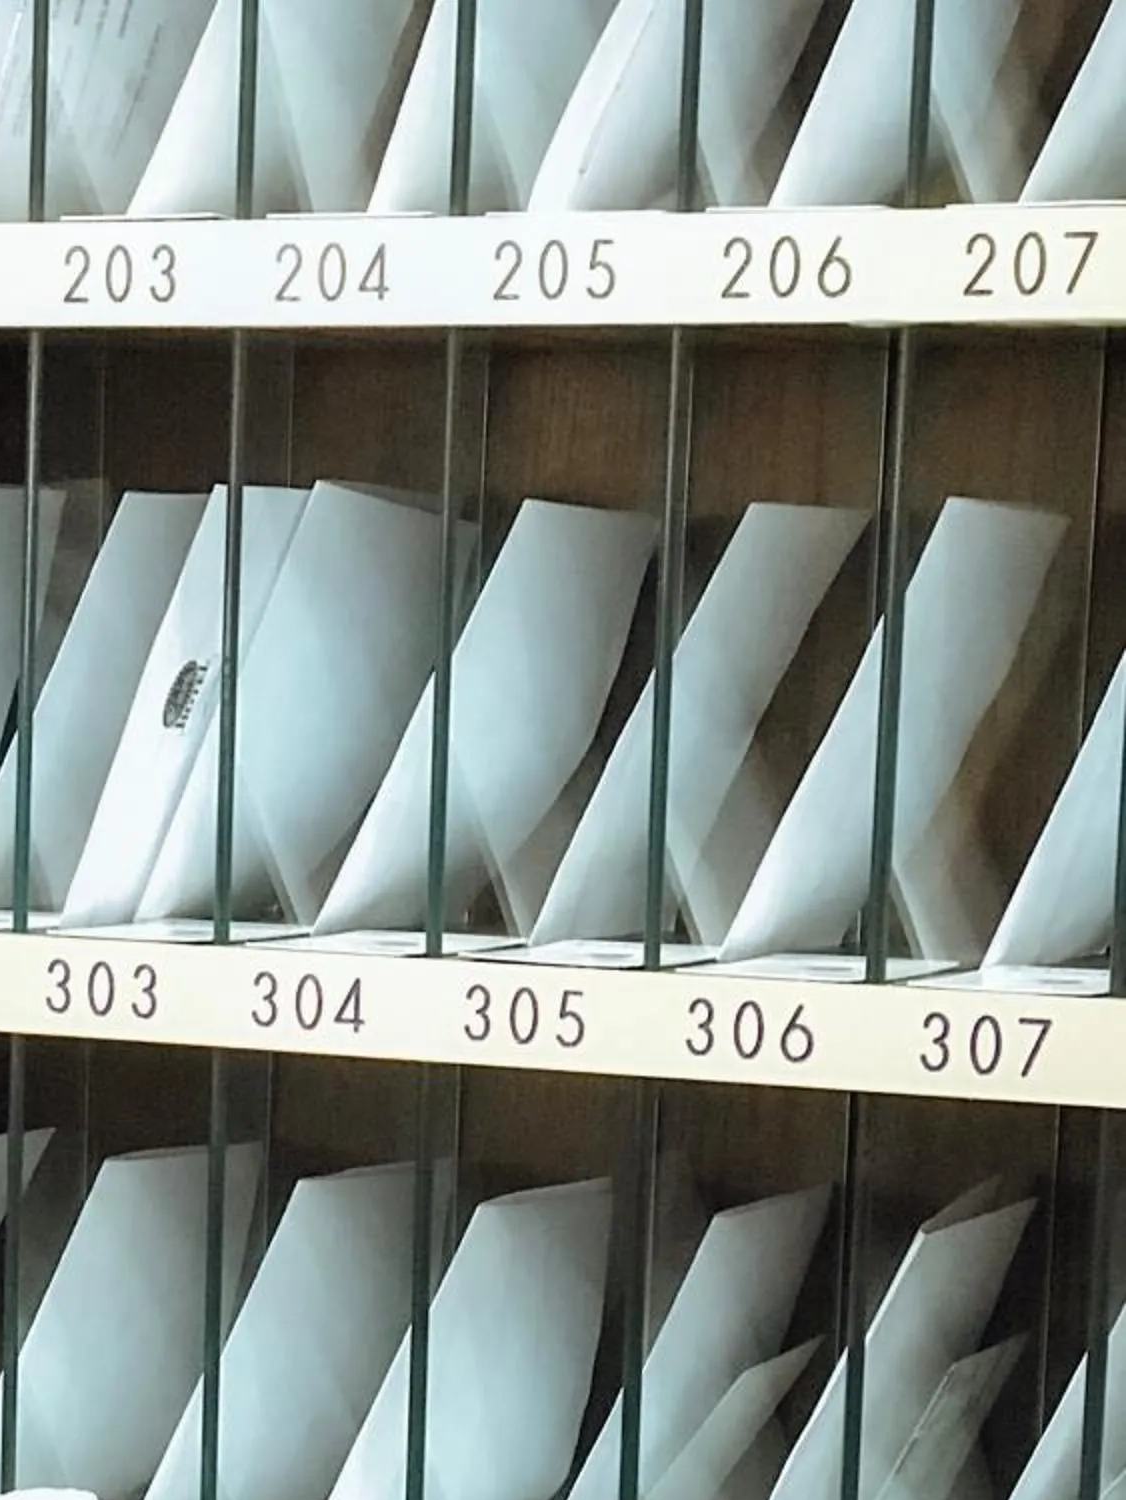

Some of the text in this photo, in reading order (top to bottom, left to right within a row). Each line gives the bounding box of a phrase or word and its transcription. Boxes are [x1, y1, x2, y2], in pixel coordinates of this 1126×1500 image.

[64, 245, 176, 303] 203
[276, 244, 389, 301] 204
[493, 239, 616, 300] 205
[721, 236, 852, 298] 206
[963, 232, 1099, 296] 207
[46, 959, 157, 1019] 303
[252, 972, 365, 1033] 304
[464, 984, 585, 1047] 305
[686, 998, 814, 1063] 306
[920, 1012, 1053, 1078] 307
